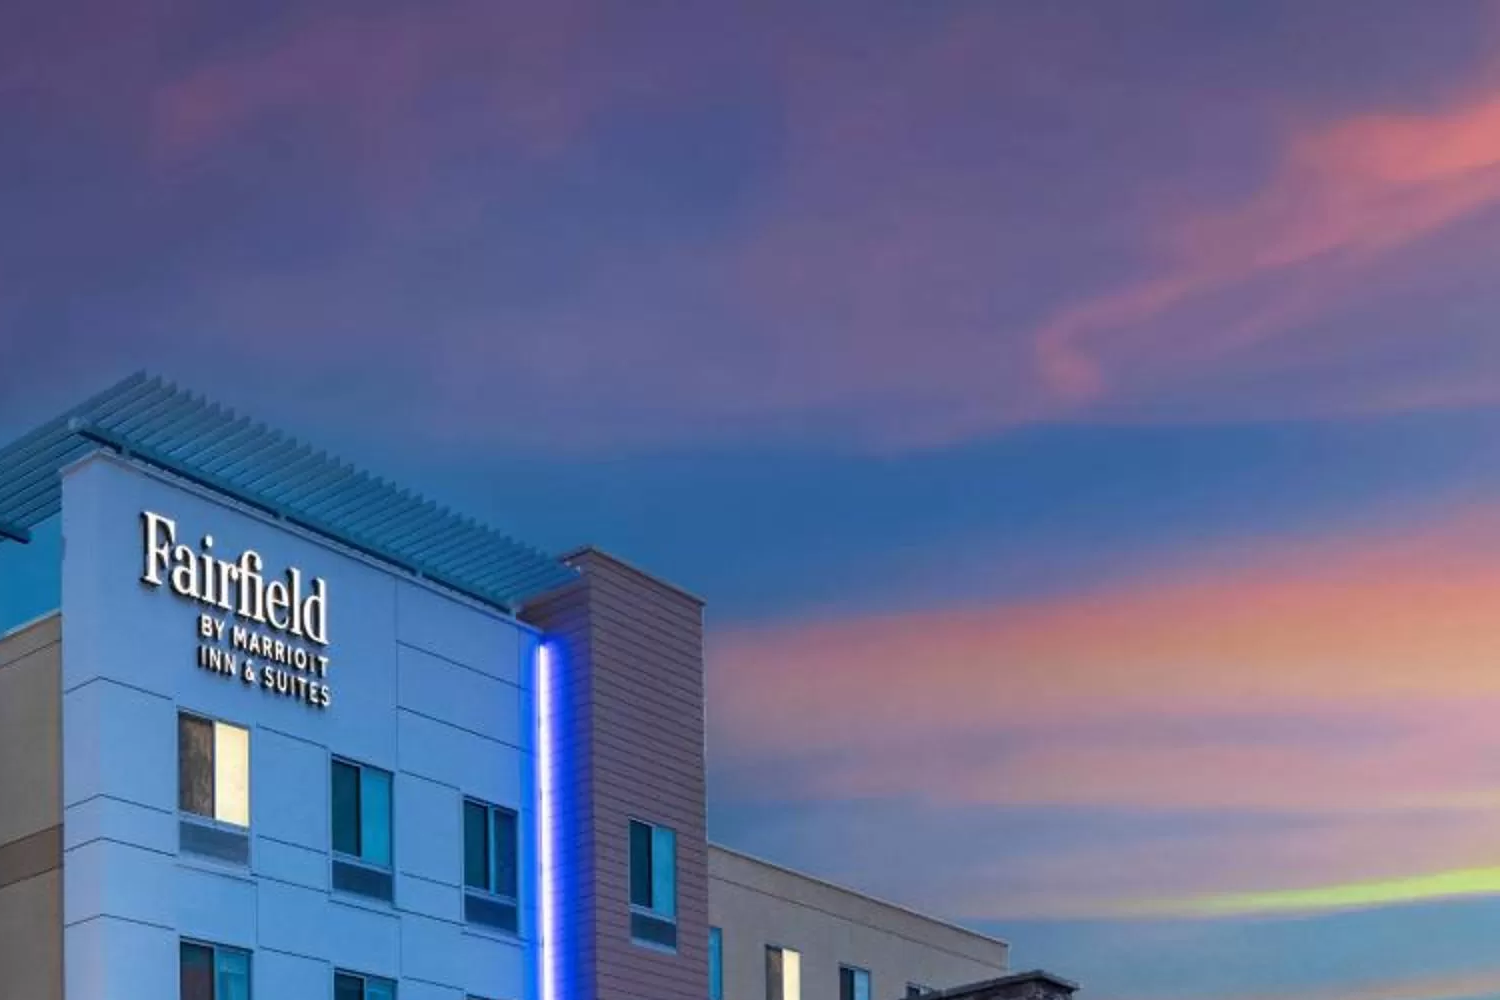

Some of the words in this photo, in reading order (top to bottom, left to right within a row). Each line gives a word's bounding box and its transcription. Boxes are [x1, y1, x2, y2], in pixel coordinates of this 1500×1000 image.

[142, 511, 330, 645] Fairfield
[200, 613, 225, 641] BY
[232, 624, 329, 678] MARRIOTT
[200, 644, 237, 676] INN
[244, 658, 258, 682] &
[264, 665, 332, 708] SUITES
